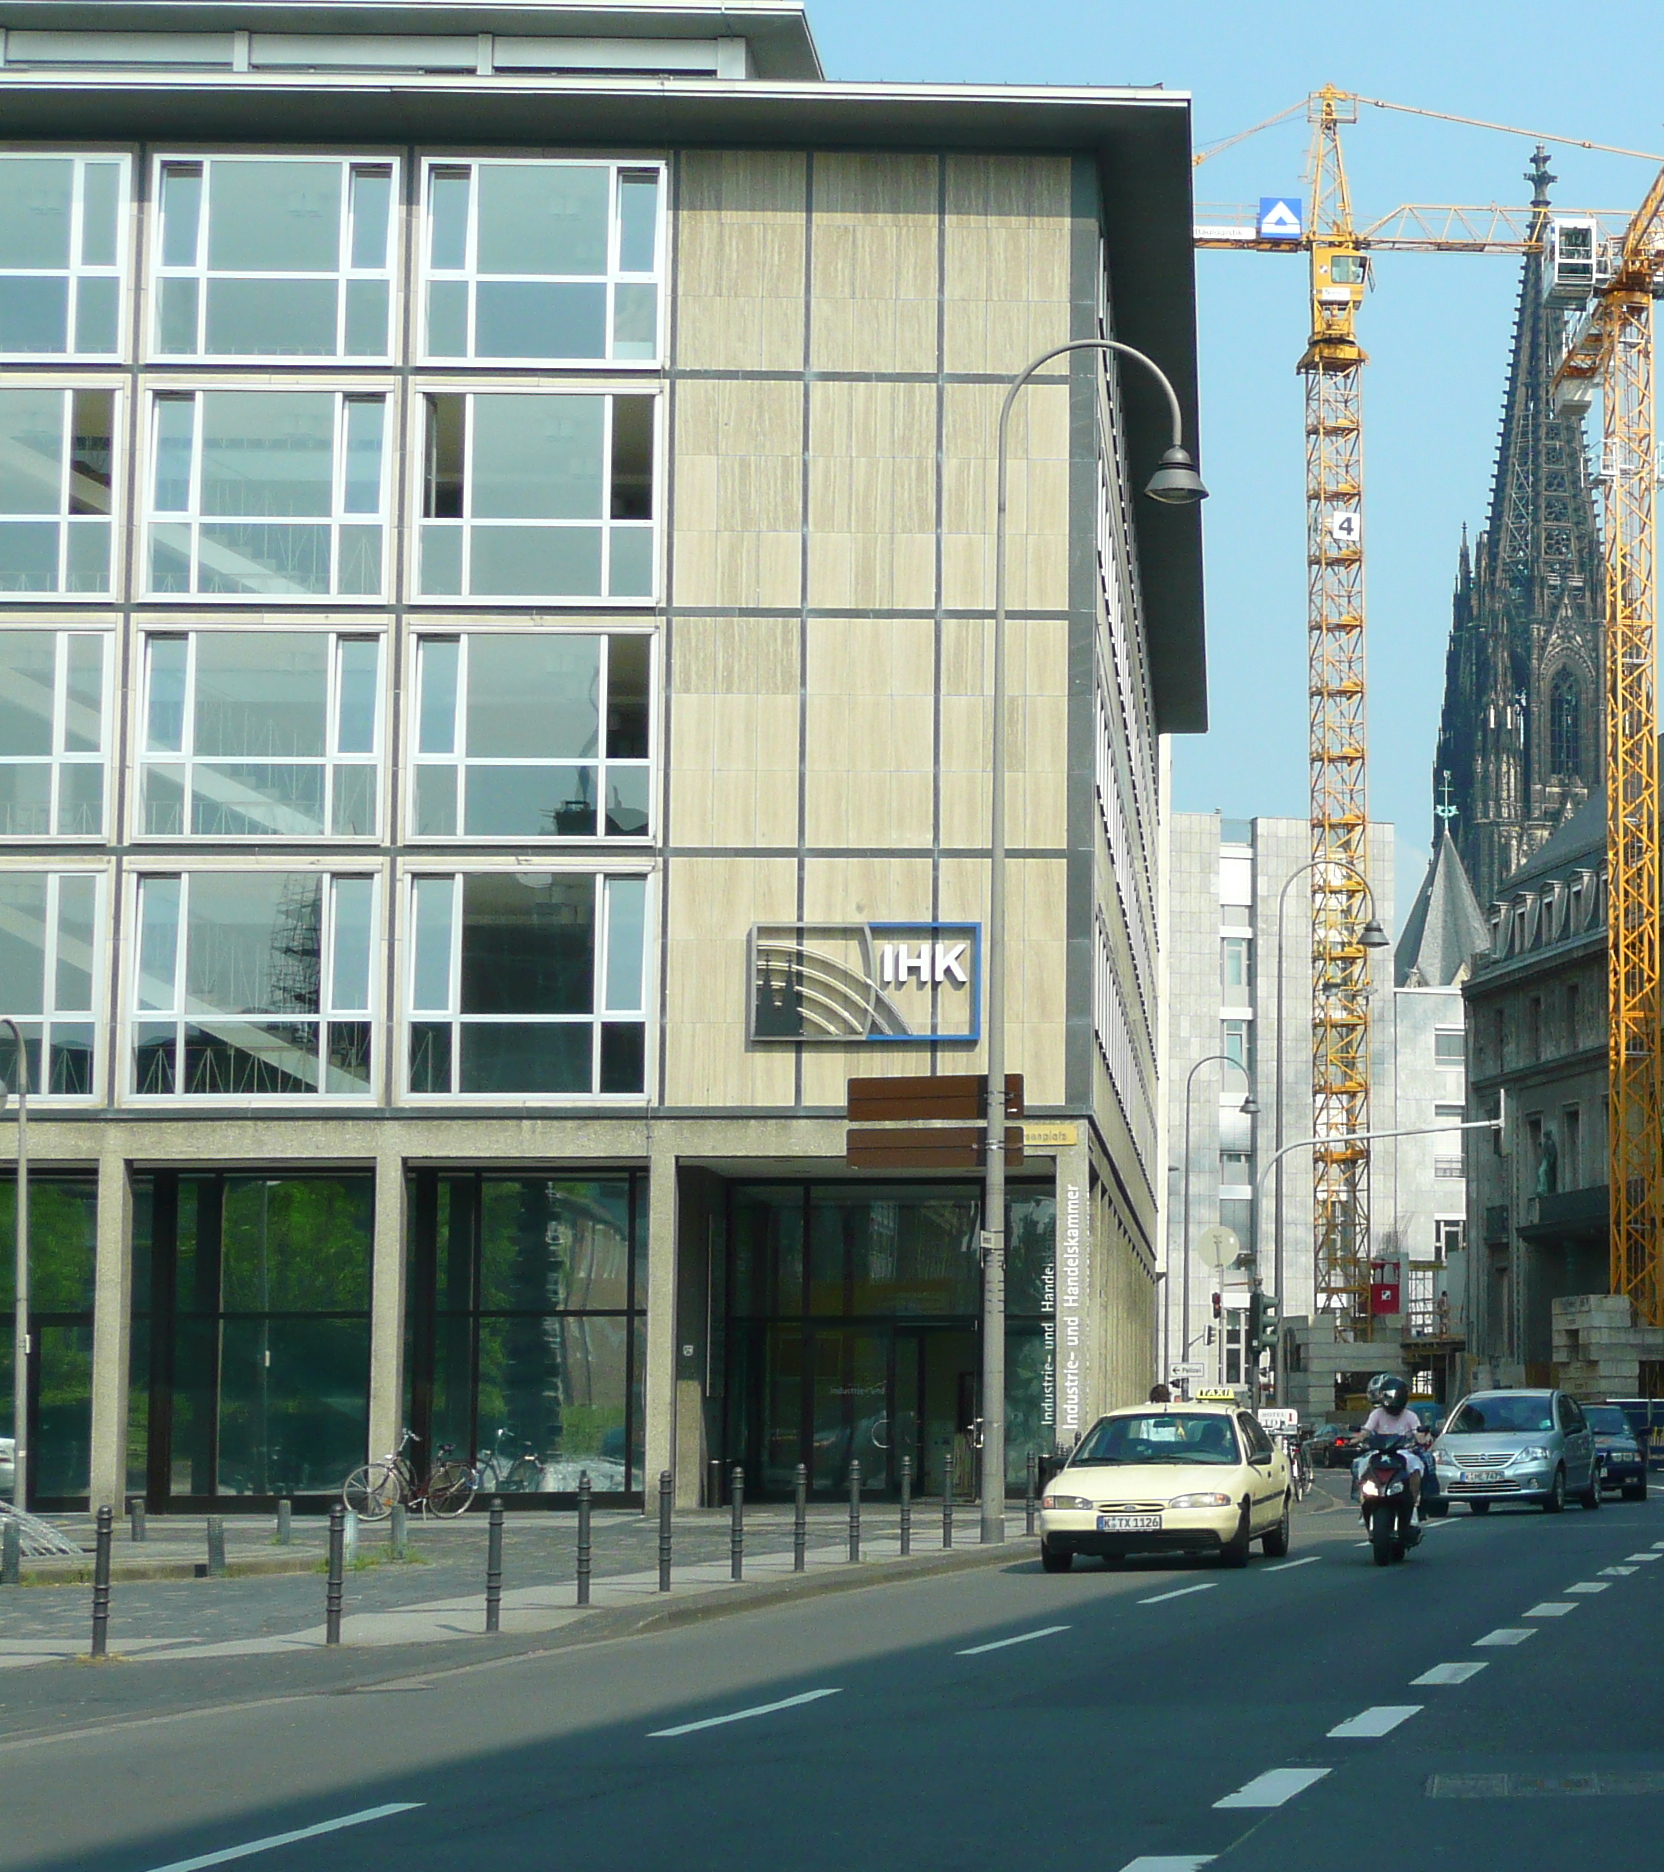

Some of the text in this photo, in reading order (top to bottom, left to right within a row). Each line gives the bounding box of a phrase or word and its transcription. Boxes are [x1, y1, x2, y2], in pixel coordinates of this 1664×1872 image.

[1338, 516, 1354, 536] 4
[882, 943, 968, 983] IHK
[1062, 1184, 1080, 1430] Industrie- und Handelskammer
[1041, 1321, 1054, 1350] und
[1041, 1354, 1054, 1426] Industrie-
[1199, 1389, 1230, 1397] TAXI
[1103, 1517, 1159, 1528] K TX 1126
